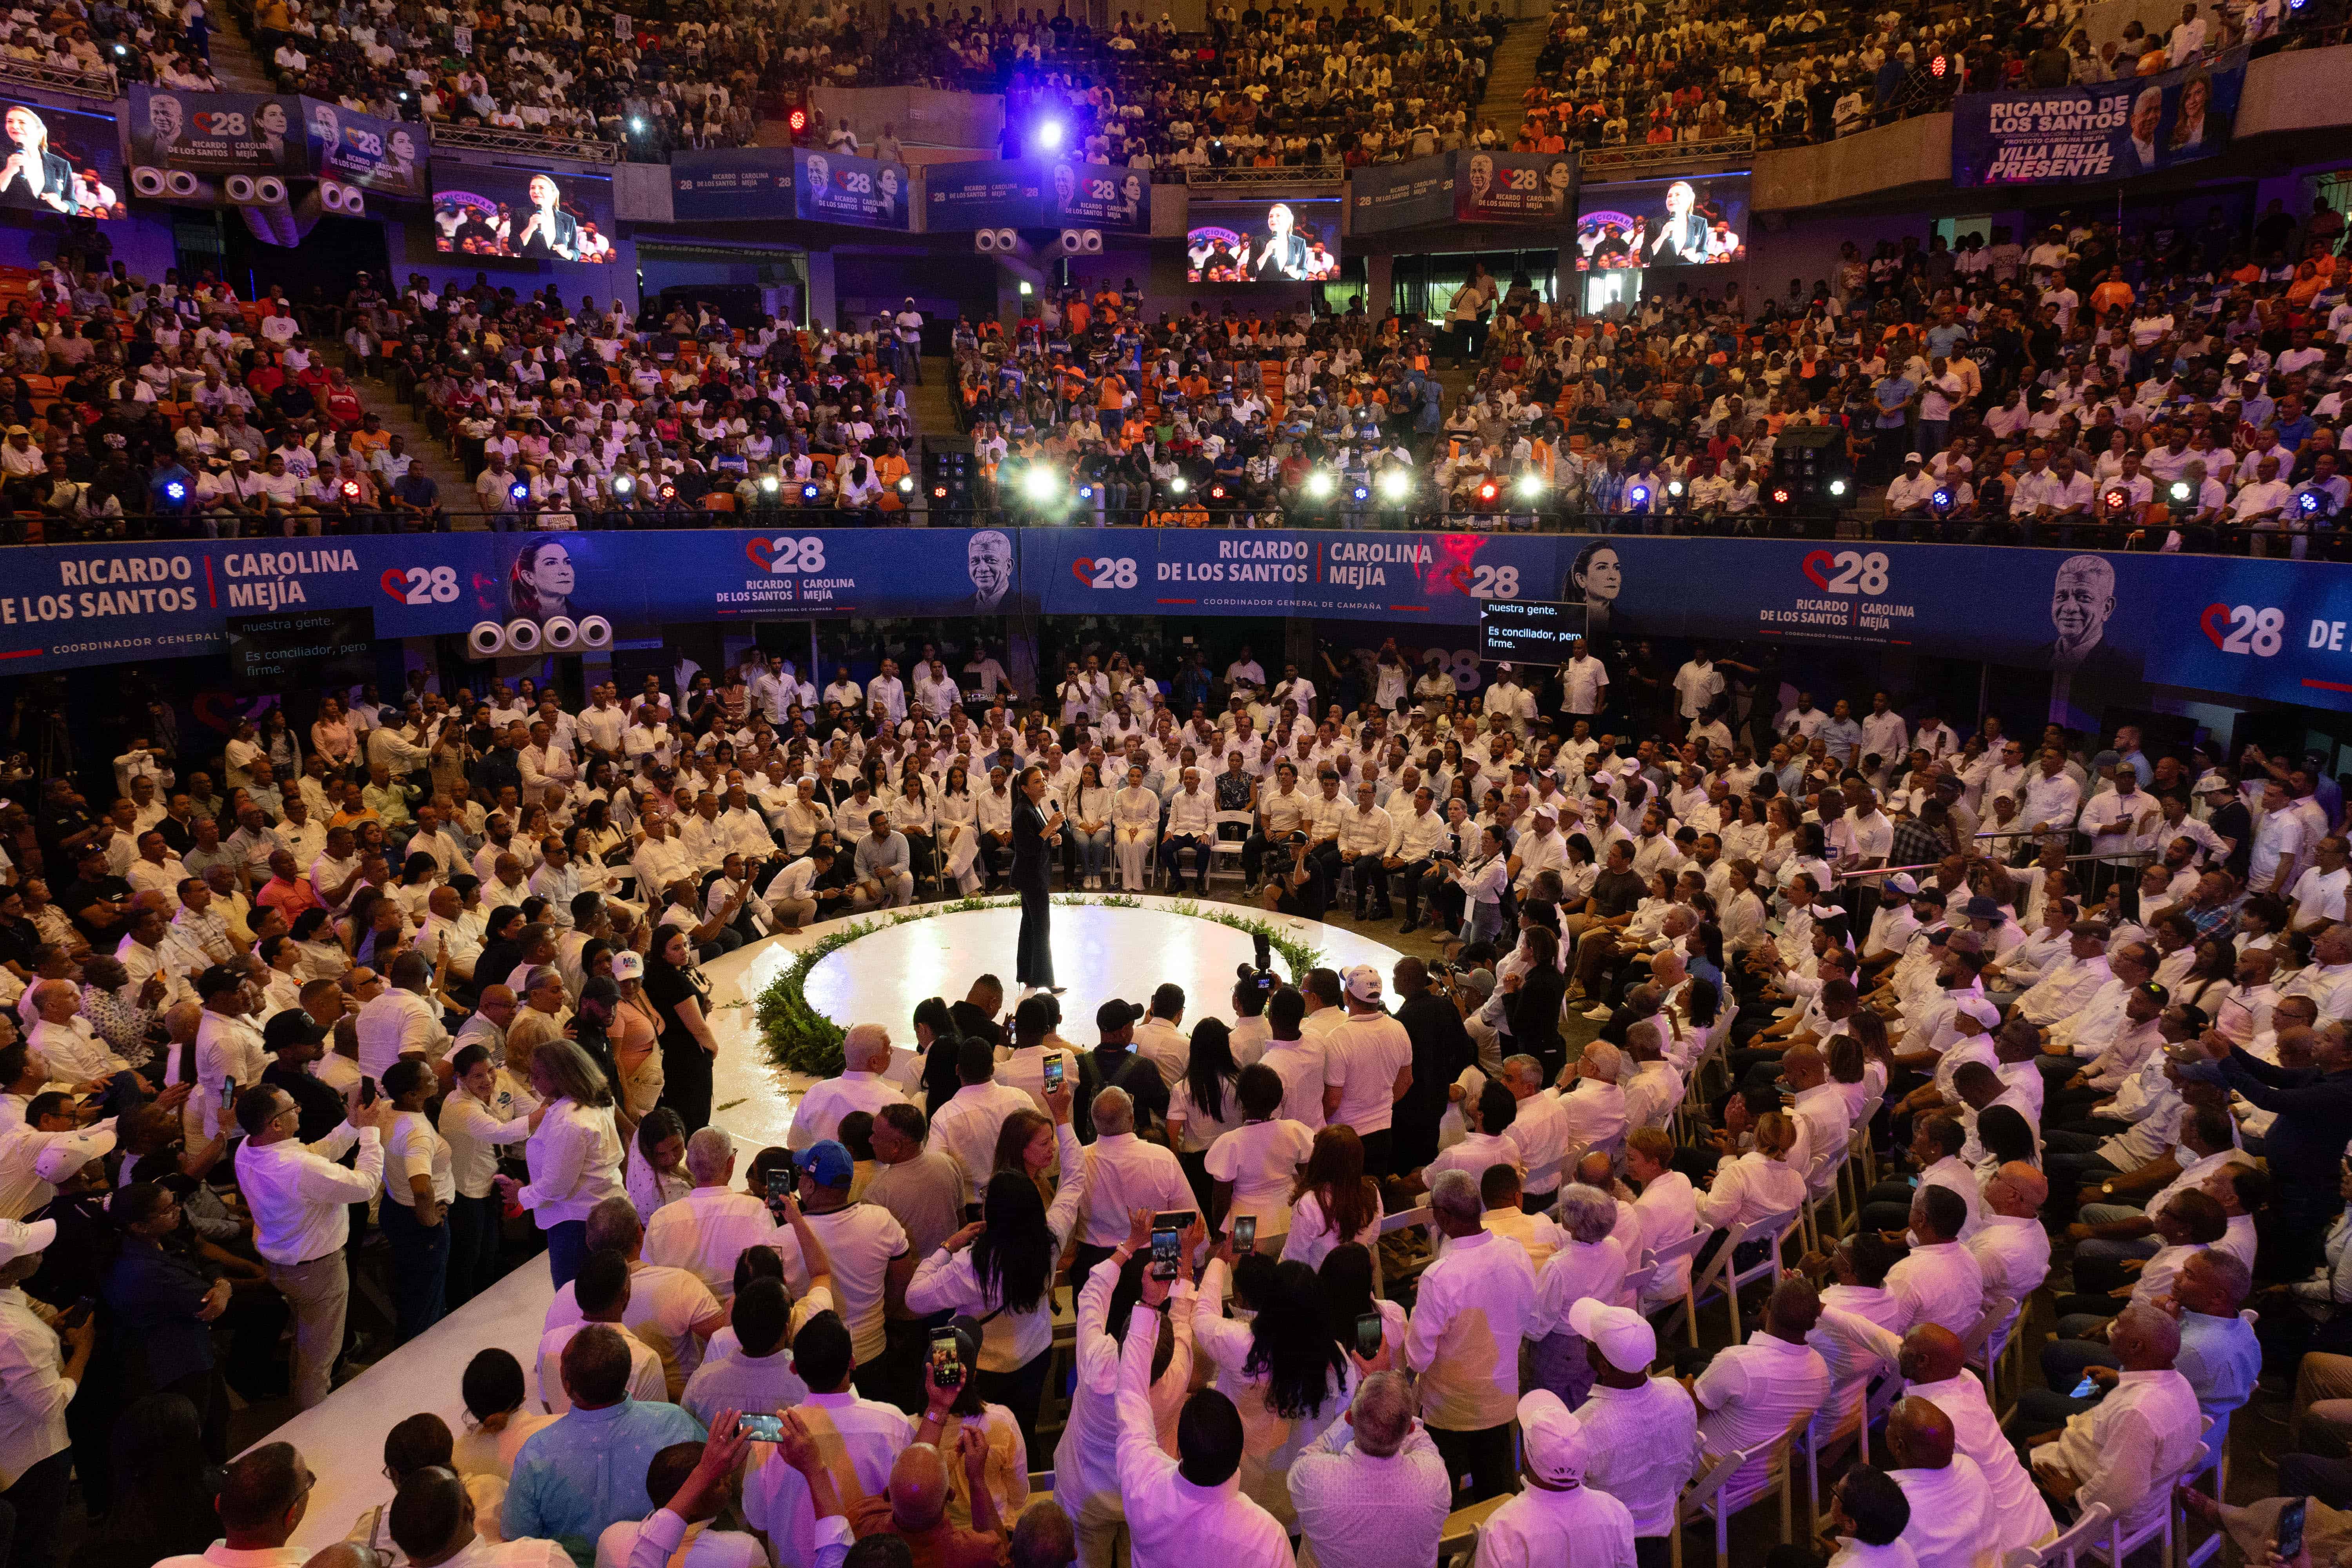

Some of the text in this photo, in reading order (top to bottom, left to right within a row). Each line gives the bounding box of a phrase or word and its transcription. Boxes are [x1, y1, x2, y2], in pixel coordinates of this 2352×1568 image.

[1990, 94, 2129, 118] RICARDO DE
[211, 112, 246, 136] 28
[1989, 111, 2126, 133] LOS SANTOS
[358, 130, 382, 156] 28
[196, 149, 229, 157] SANTOS
[236, 149, 259, 159] MEJÍA
[347, 154, 370, 166] RICARDO
[2000, 142, 2109, 162] VILLA MELLA
[339, 159, 349, 168] LOS
[350, 162, 371, 173] SANTOS
[375, 162, 405, 173] CAROLINA
[375, 169, 393, 179] MEJÍA
[1987, 156, 2114, 179] PRESENTE
[681, 180, 693, 190] 28
[779, 177, 791, 187] 28
[846, 172, 871, 194] 28
[1443, 179, 1454, 190] 28
[1511, 169, 1537, 190] 28
[934, 192, 946, 202] 28
[1025, 187, 1038, 197] 28
[1092, 179, 1115, 200] 28
[834, 195, 858, 203] RICARDO
[837, 202, 858, 211] SANTOS
[862, 199, 888, 207] CAROLINA
[1359, 196, 1371, 206] 28
[1526, 201, 1543, 209] MEJÍA
[863, 205, 878, 214] MEJÍA
[1107, 211, 1121, 220] MEJÍA
[771, 536, 826, 573] 28
[1219, 541, 1308, 559] RICARDO
[1330, 543, 1433, 564] CAROLINA
[60, 556, 192, 586] RICARDO
[224, 549, 359, 578] CAROLINA
[1092, 557, 1138, 589] 28
[1157, 563, 1308, 583] DE LOS SANTOS
[1329, 563, 1386, 590] MEJÍA
[1828, 551, 1889, 595] 28
[406, 566, 461, 605] 28
[746, 579, 792, 590] RICARDO
[803, 579, 855, 589] CAROLINA
[1470, 565, 1519, 599] 28
[228, 575, 307, 612] MEJÍA
[716, 591, 793, 602] DE LOS SANTOS
[804, 588, 833, 602] MEJÍA
[0, 586, 197, 624] E LOS SANTOS
[1203, 598, 1273, 606] COORDINADOR
[1277, 599, 1318, 608] GENERAL
[1337, 601, 1381, 611] CAMPAÑA
[1488, 604, 1557, 616] nuestra gente.
[1796, 599, 1849, 612] RICARDO
[1861, 603, 1915, 617] CAROLINA
[242, 616, 334, 633] nuestra gente.
[1760, 610, 1847, 626] DE LOS SANTOS
[1860, 615, 1890, 631] MEJÍA
[1488, 626, 1582, 642] Es conciliador, pero
[2222, 605, 2285, 657] 28
[2308, 619, 2347, 651] DE
[53, 638, 152, 654] COORDINADOR
[158, 632, 220, 645] GENERAL
[1488, 639, 1515, 649] firme.
[245, 642, 367, 662] Es conciliador, pero
[247, 664, 285, 676] firme.
